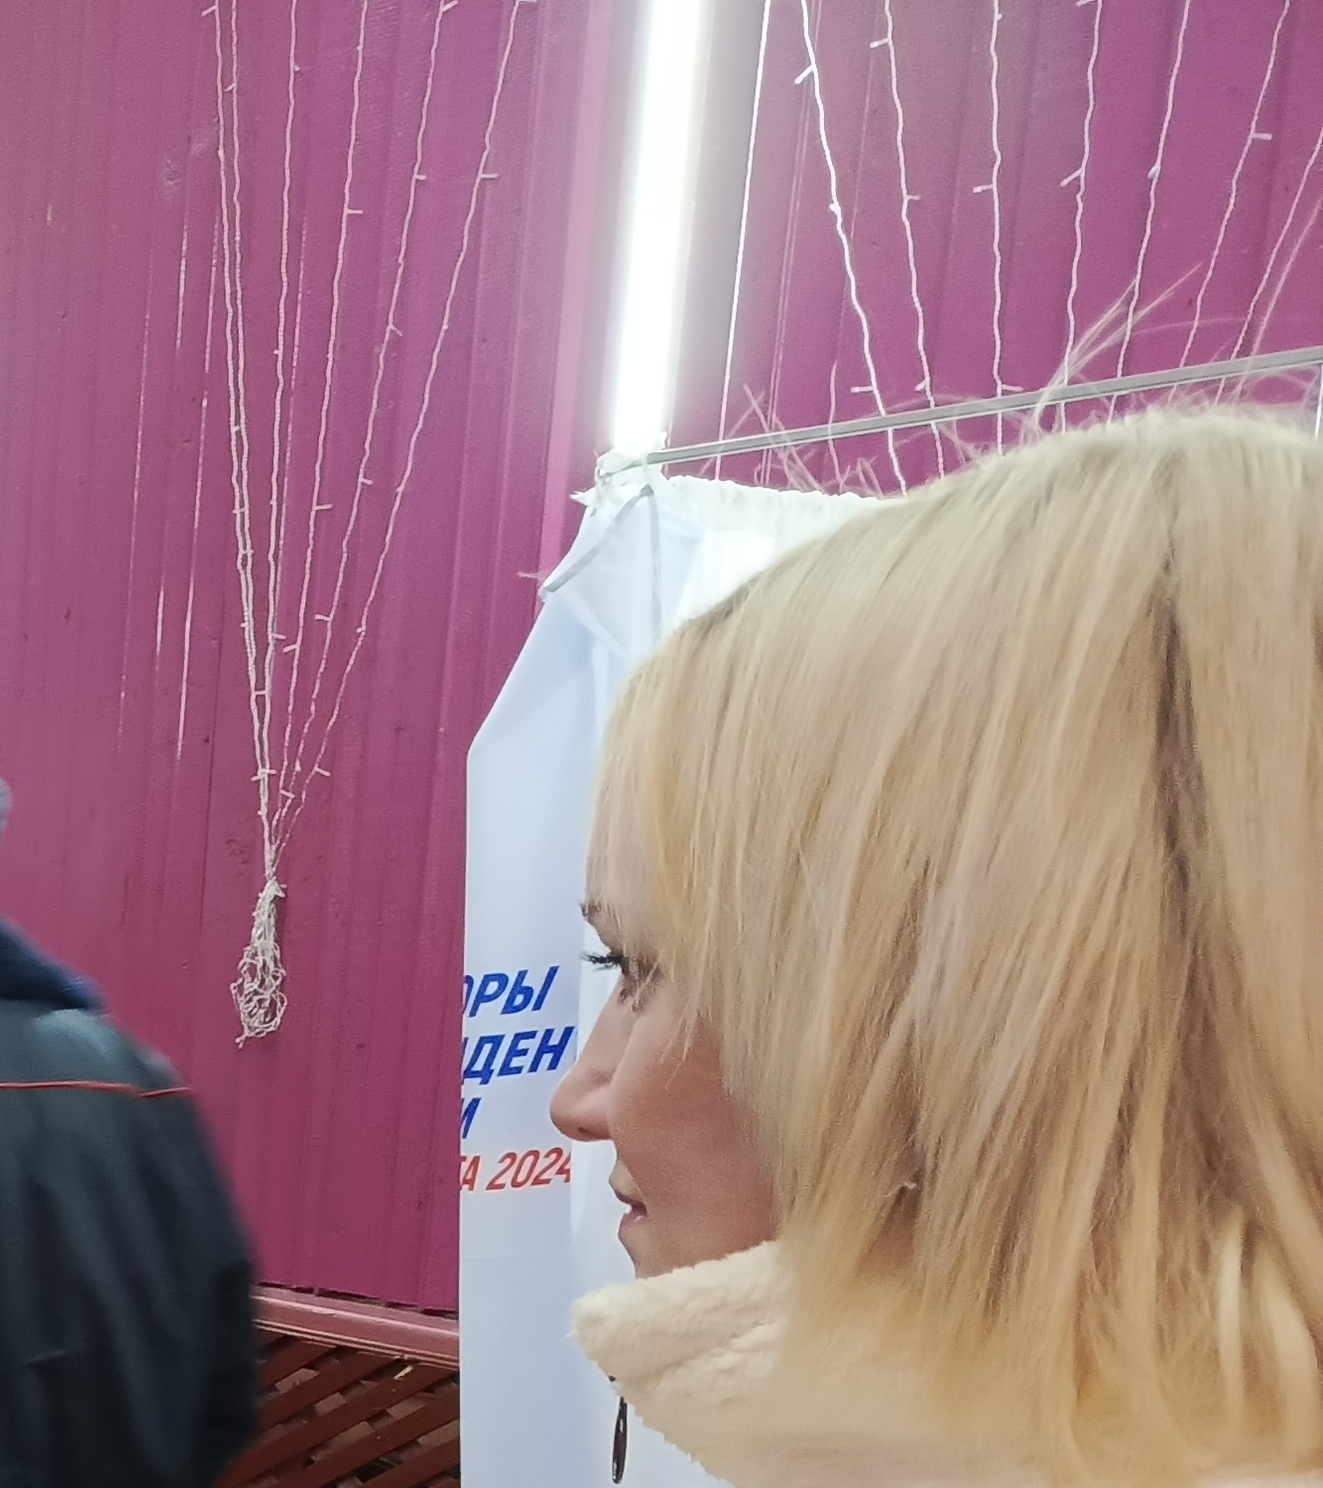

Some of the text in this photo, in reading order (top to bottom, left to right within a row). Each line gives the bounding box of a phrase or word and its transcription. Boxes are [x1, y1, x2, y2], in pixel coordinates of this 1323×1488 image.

[461, 1026, 575, 1085] ДЕН
[460, 1147, 572, 1191] А 2024
